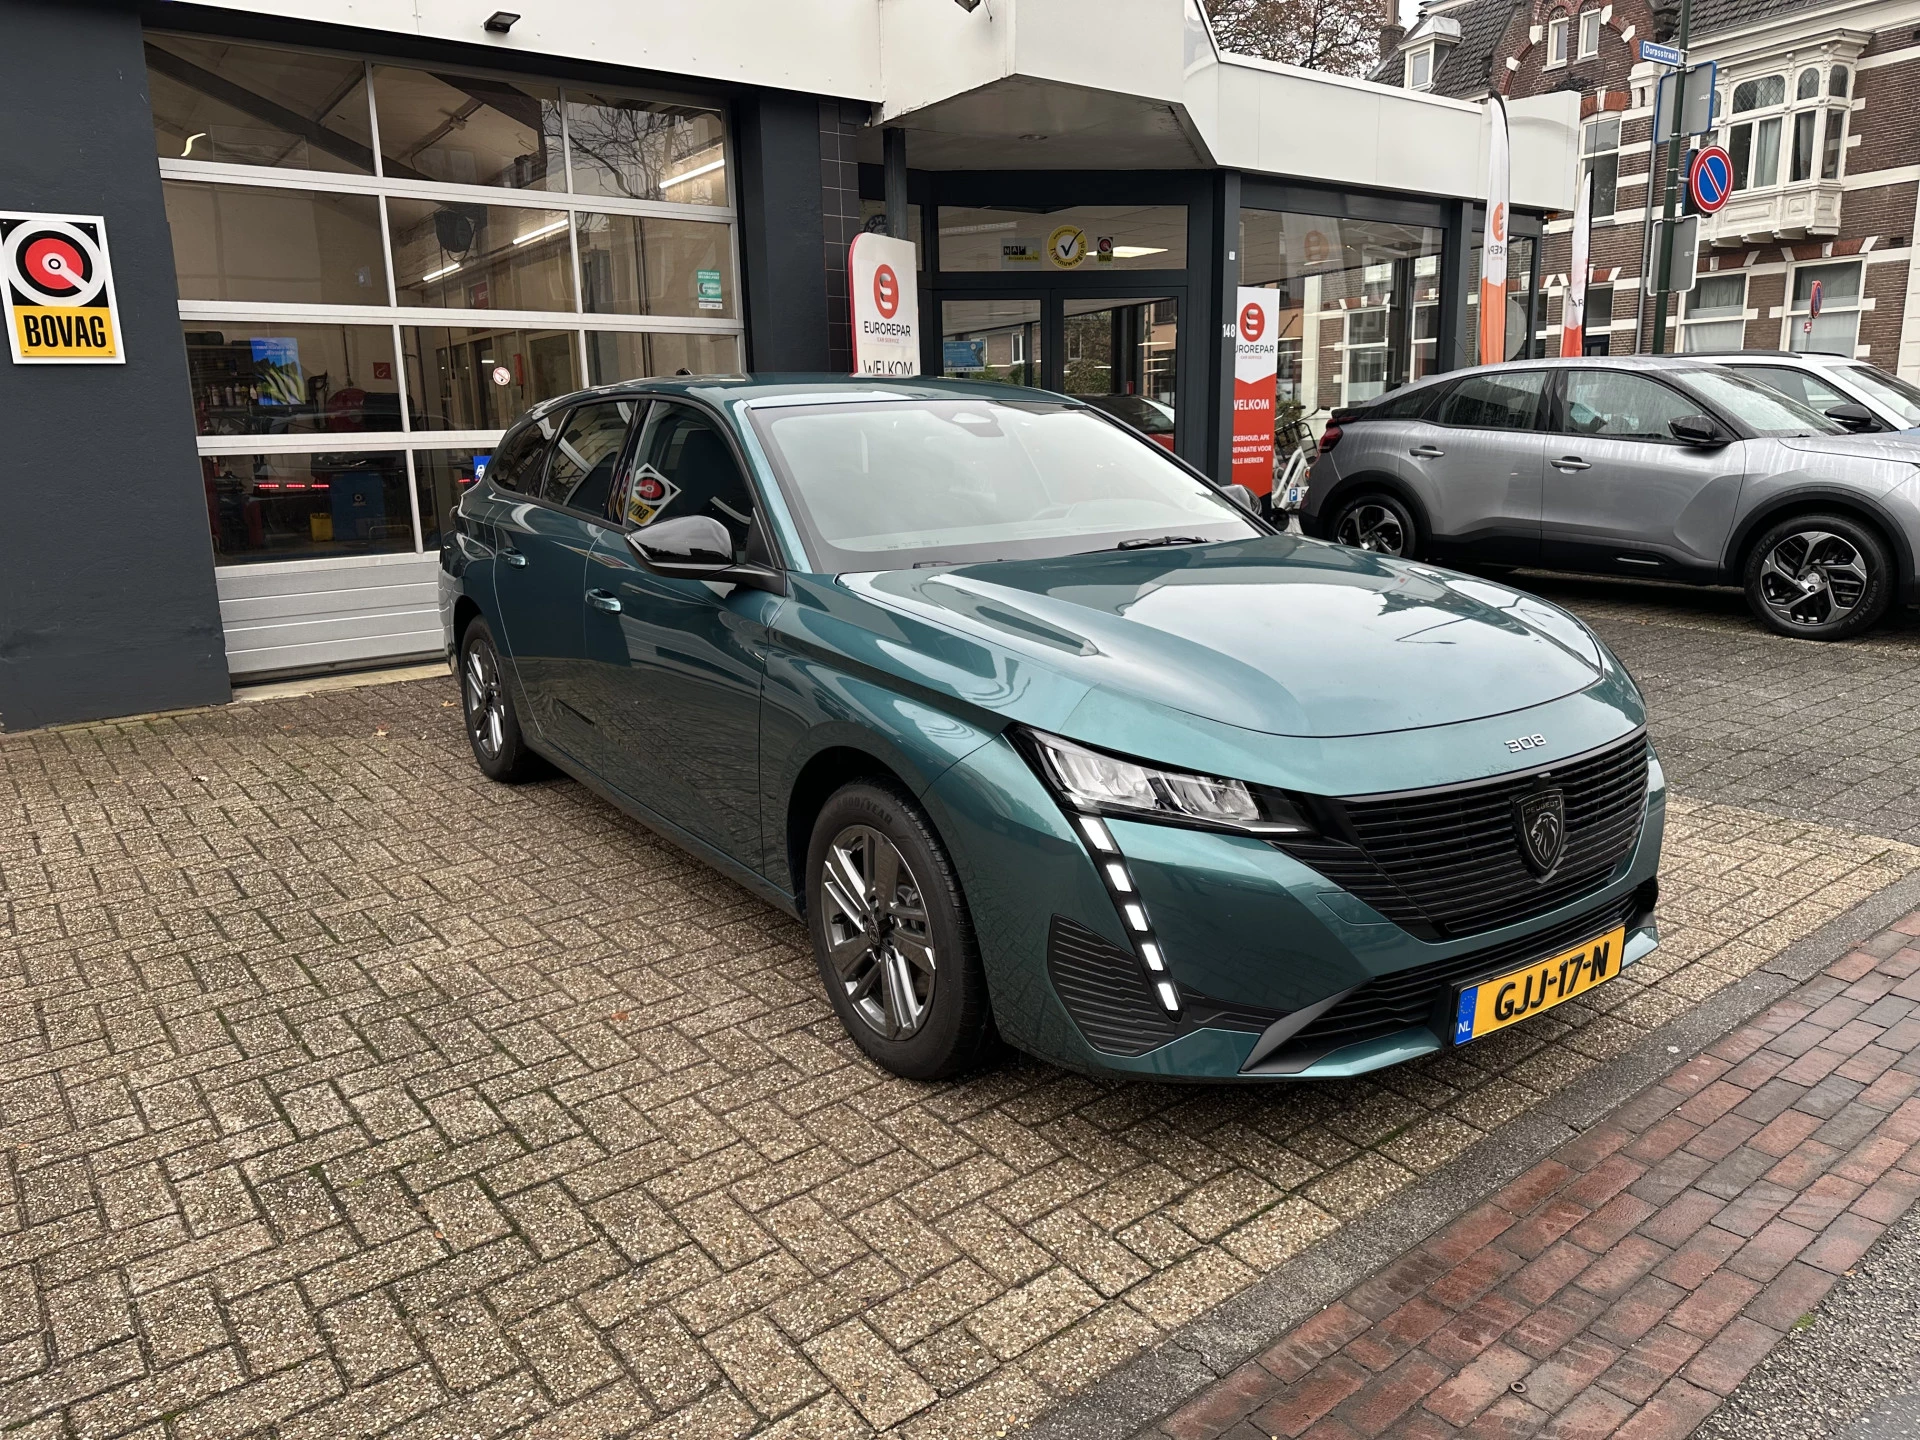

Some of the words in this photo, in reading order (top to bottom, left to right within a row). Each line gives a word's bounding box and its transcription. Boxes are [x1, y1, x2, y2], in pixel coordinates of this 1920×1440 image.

[1645, 45, 1677, 60] Dorpsstraat
[23, 315, 107, 348] BOVAG
[864, 320, 911, 337] EUROREPAR
[1222, 323, 1236, 338] 148
[1260, 433, 1270, 441] APK
[1504, 733, 1547, 753] 308
[1526, 800, 1559, 814] PEUGEOT
[1494, 941, 1610, 1021] GJJ-17-N
[1458, 1020, 1471, 1034] NL
